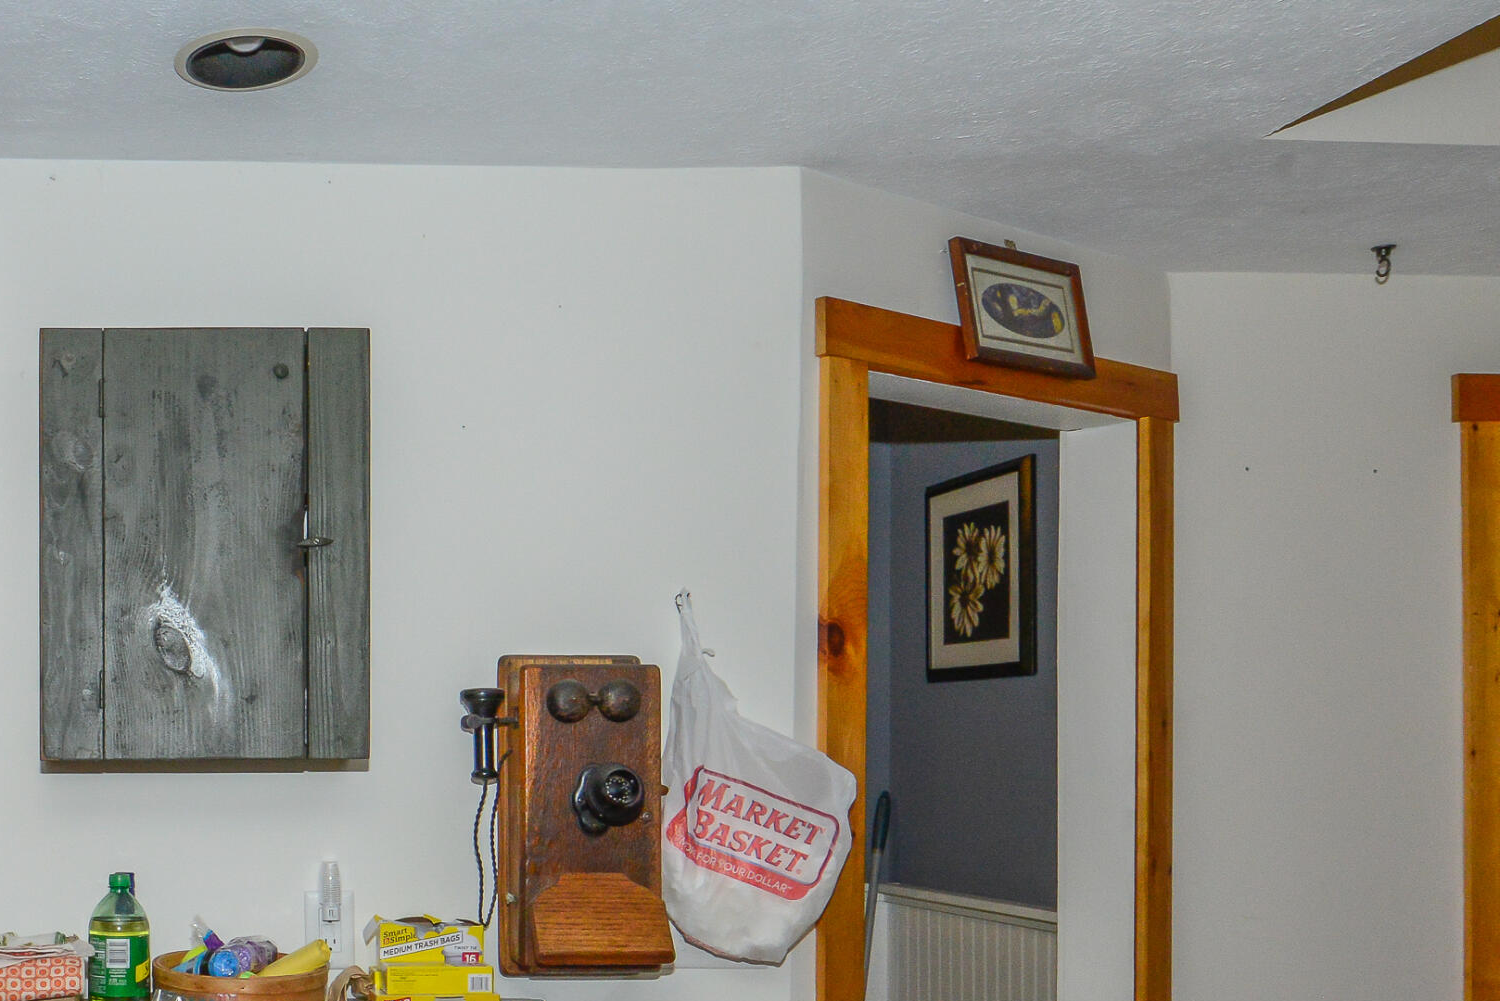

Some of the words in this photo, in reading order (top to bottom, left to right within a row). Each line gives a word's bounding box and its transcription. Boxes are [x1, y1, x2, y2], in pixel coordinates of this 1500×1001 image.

[698, 778, 823, 846] MARKET
[693, 806, 809, 872] BASKET
[696, 852, 716, 867] FOR
[718, 859, 746, 876] YOUR
[748, 869, 788, 894] DOLLAR
[383, 928, 408, 938] Smart
[383, 945, 412, 957] MEDIUM
[414, 939, 438, 950] TRASH
[440, 934, 460, 944] BAGS
[465, 954, 476, 964] 16
